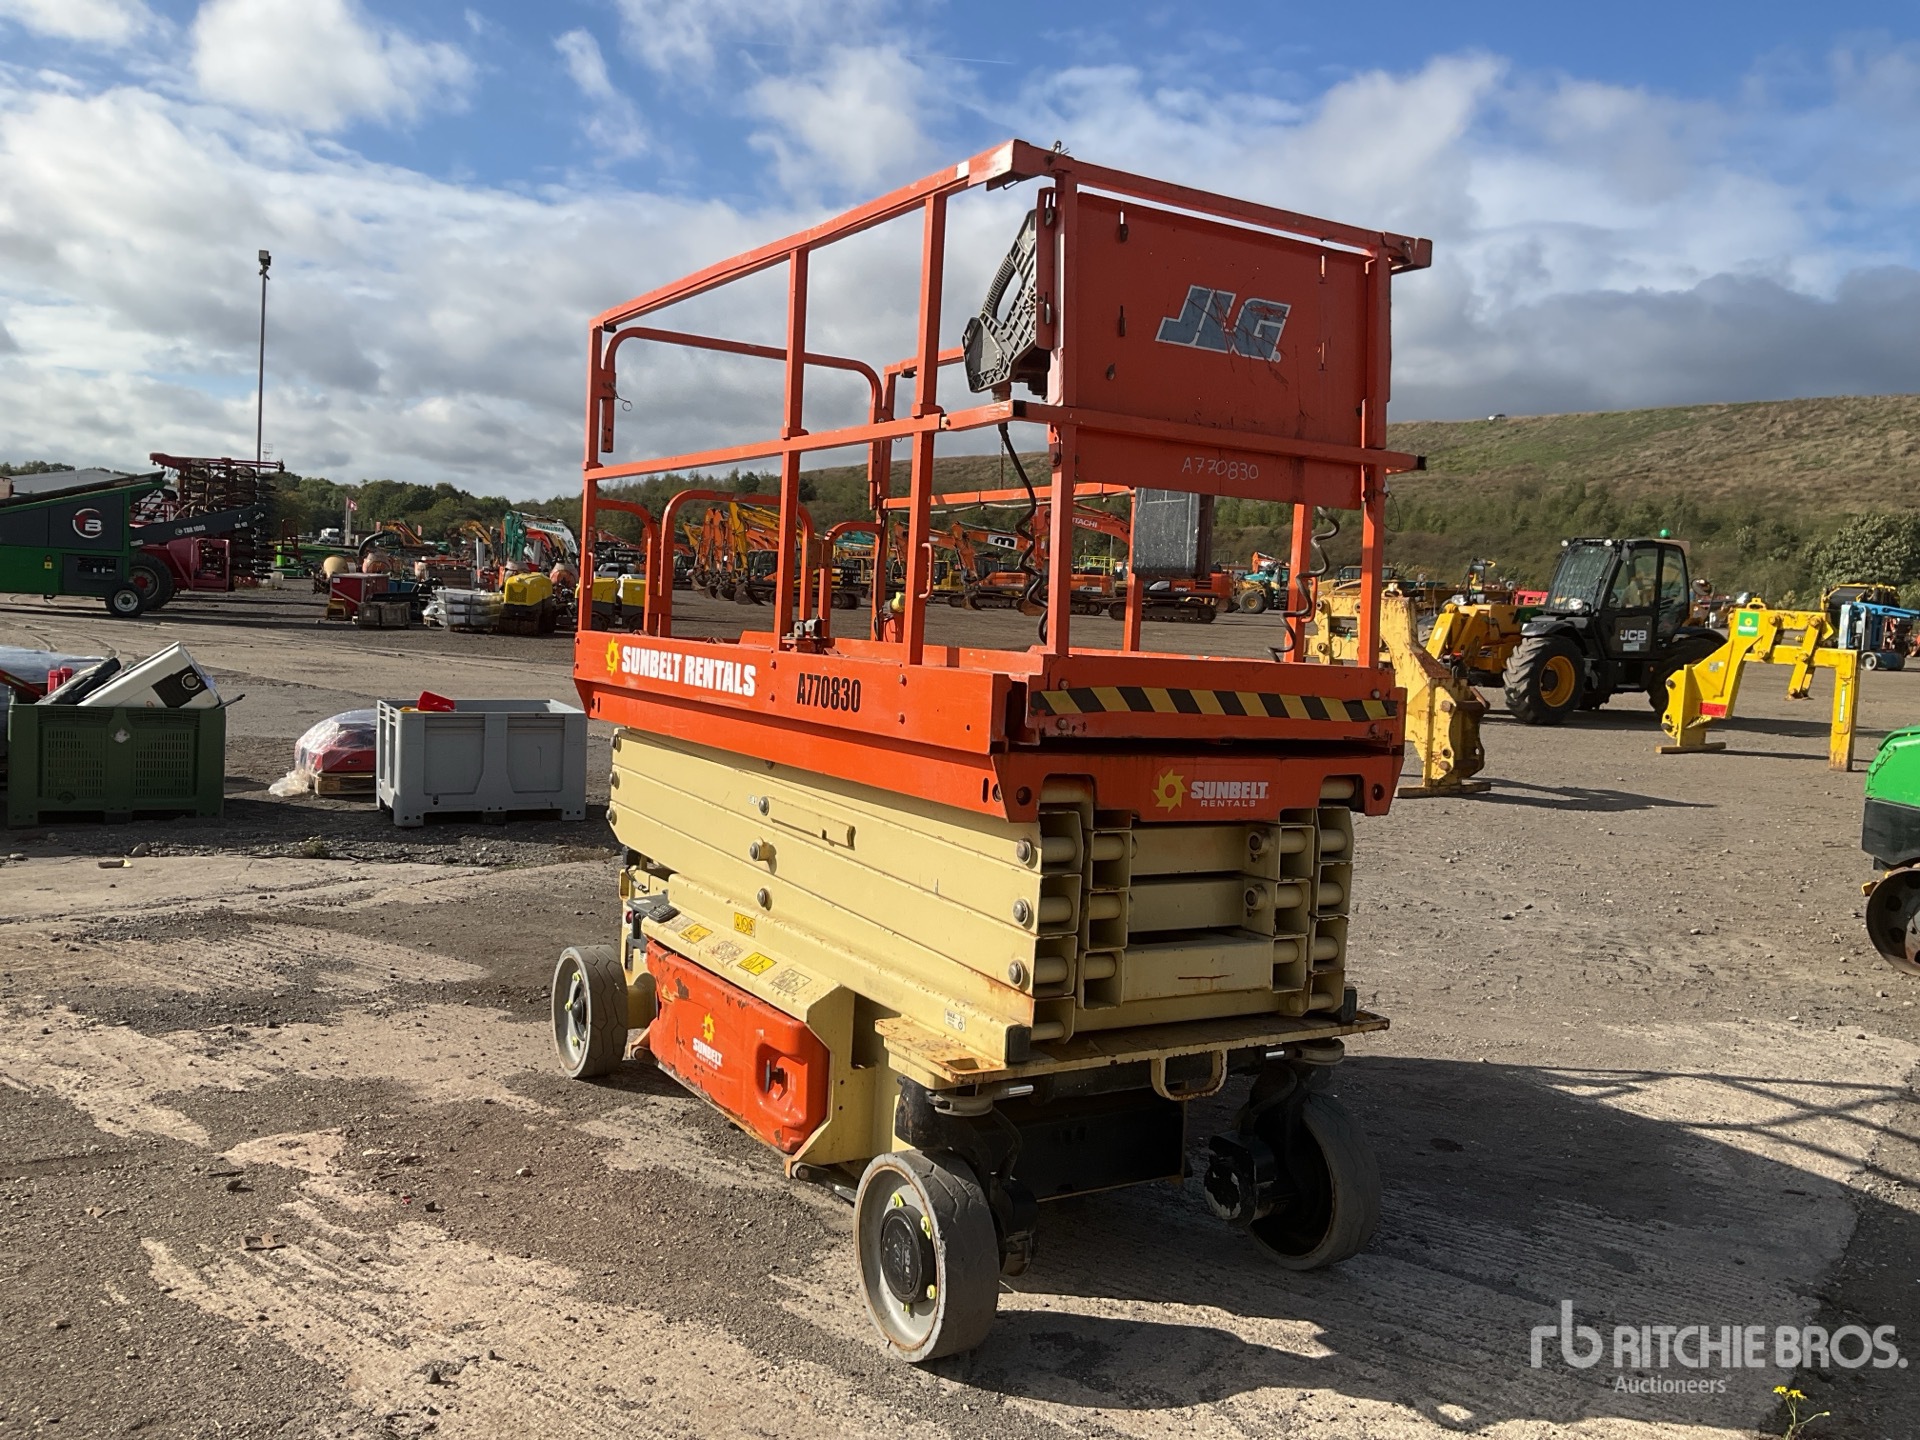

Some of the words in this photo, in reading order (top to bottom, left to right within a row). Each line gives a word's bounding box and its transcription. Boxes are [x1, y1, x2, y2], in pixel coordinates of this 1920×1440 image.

[1155, 284, 1291, 362] JLG
[1181, 456, 1259, 480] A770830
[1072, 516, 1098, 528] ITACHI
[1620, 629, 1647, 641] JCB
[621, 645, 683, 684] SUNBELT
[683, 654, 756, 697] RENTALS
[796, 672, 862, 713] A770830
[1190, 781, 1269, 799] SUNBELT
[1200, 799, 1256, 807] RENTALS
[692, 1037, 723, 1067] SUNBELT
